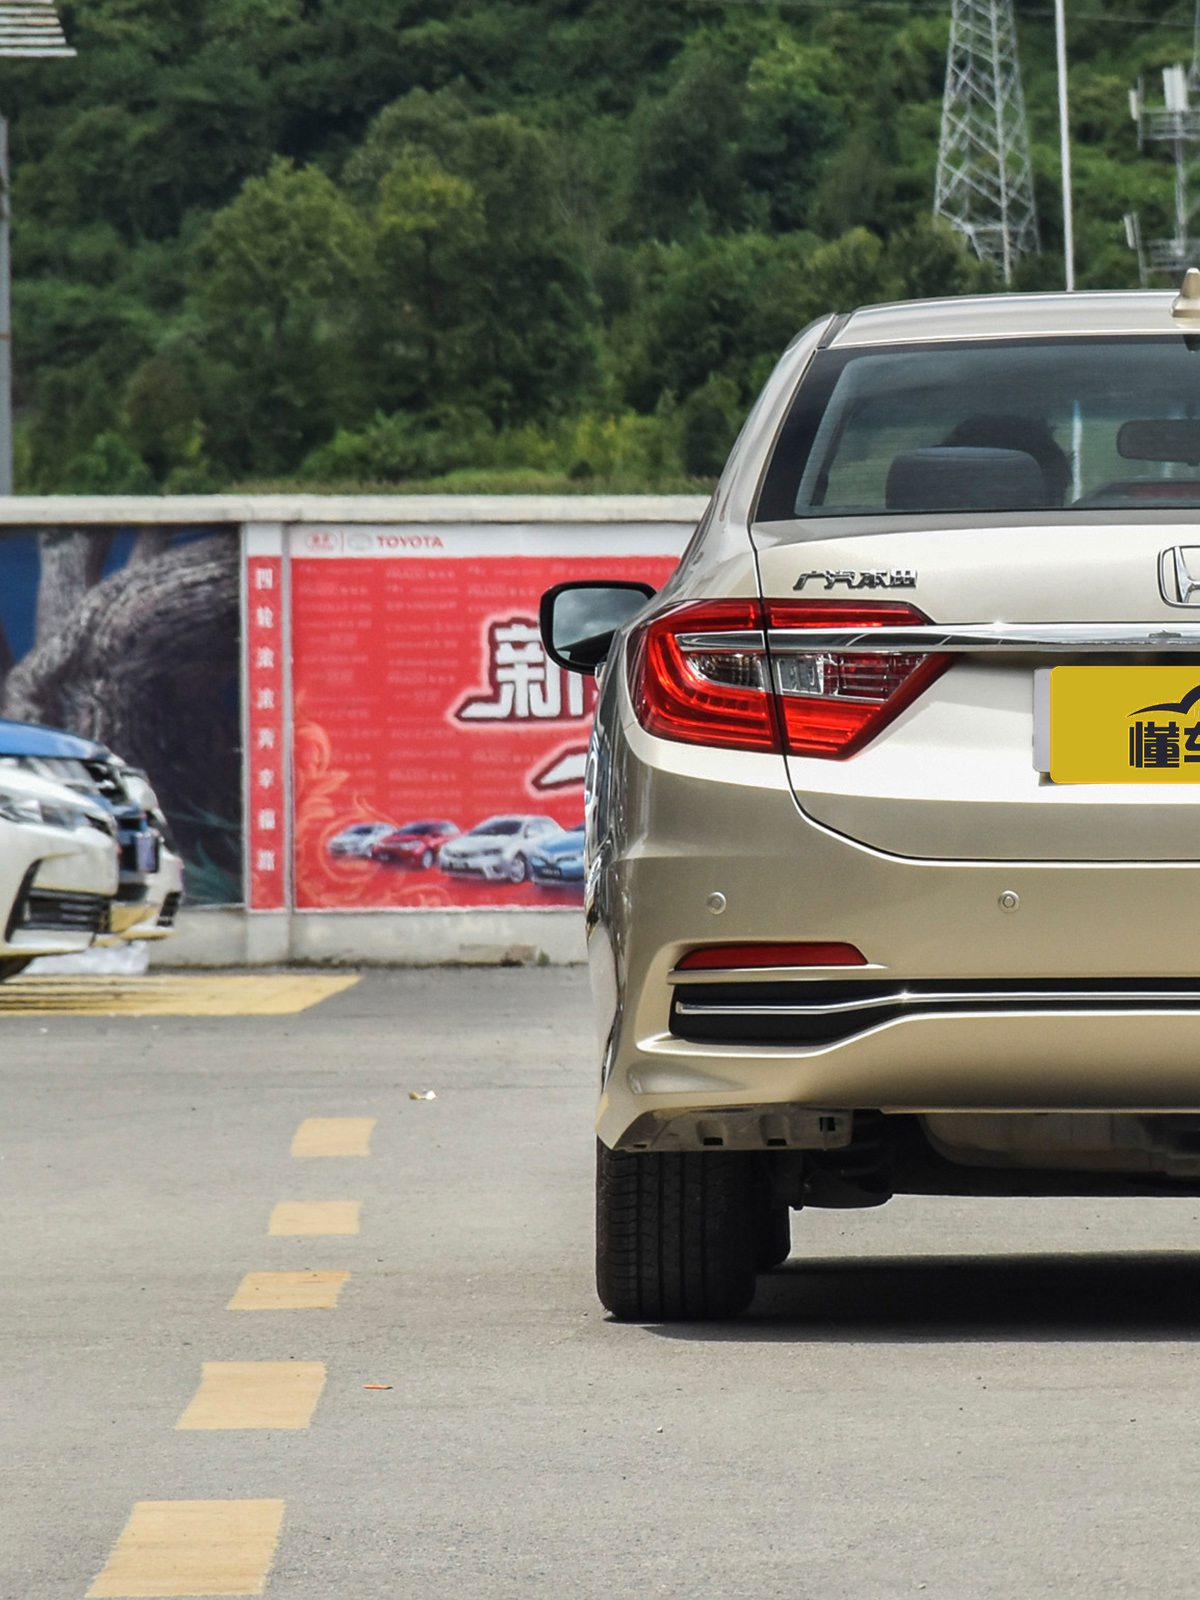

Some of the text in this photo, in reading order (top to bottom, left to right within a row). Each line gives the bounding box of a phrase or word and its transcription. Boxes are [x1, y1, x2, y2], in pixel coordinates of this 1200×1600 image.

[377, 534, 444, 549] TOYOTA
[793, 569, 917, 590] 广汽本田
